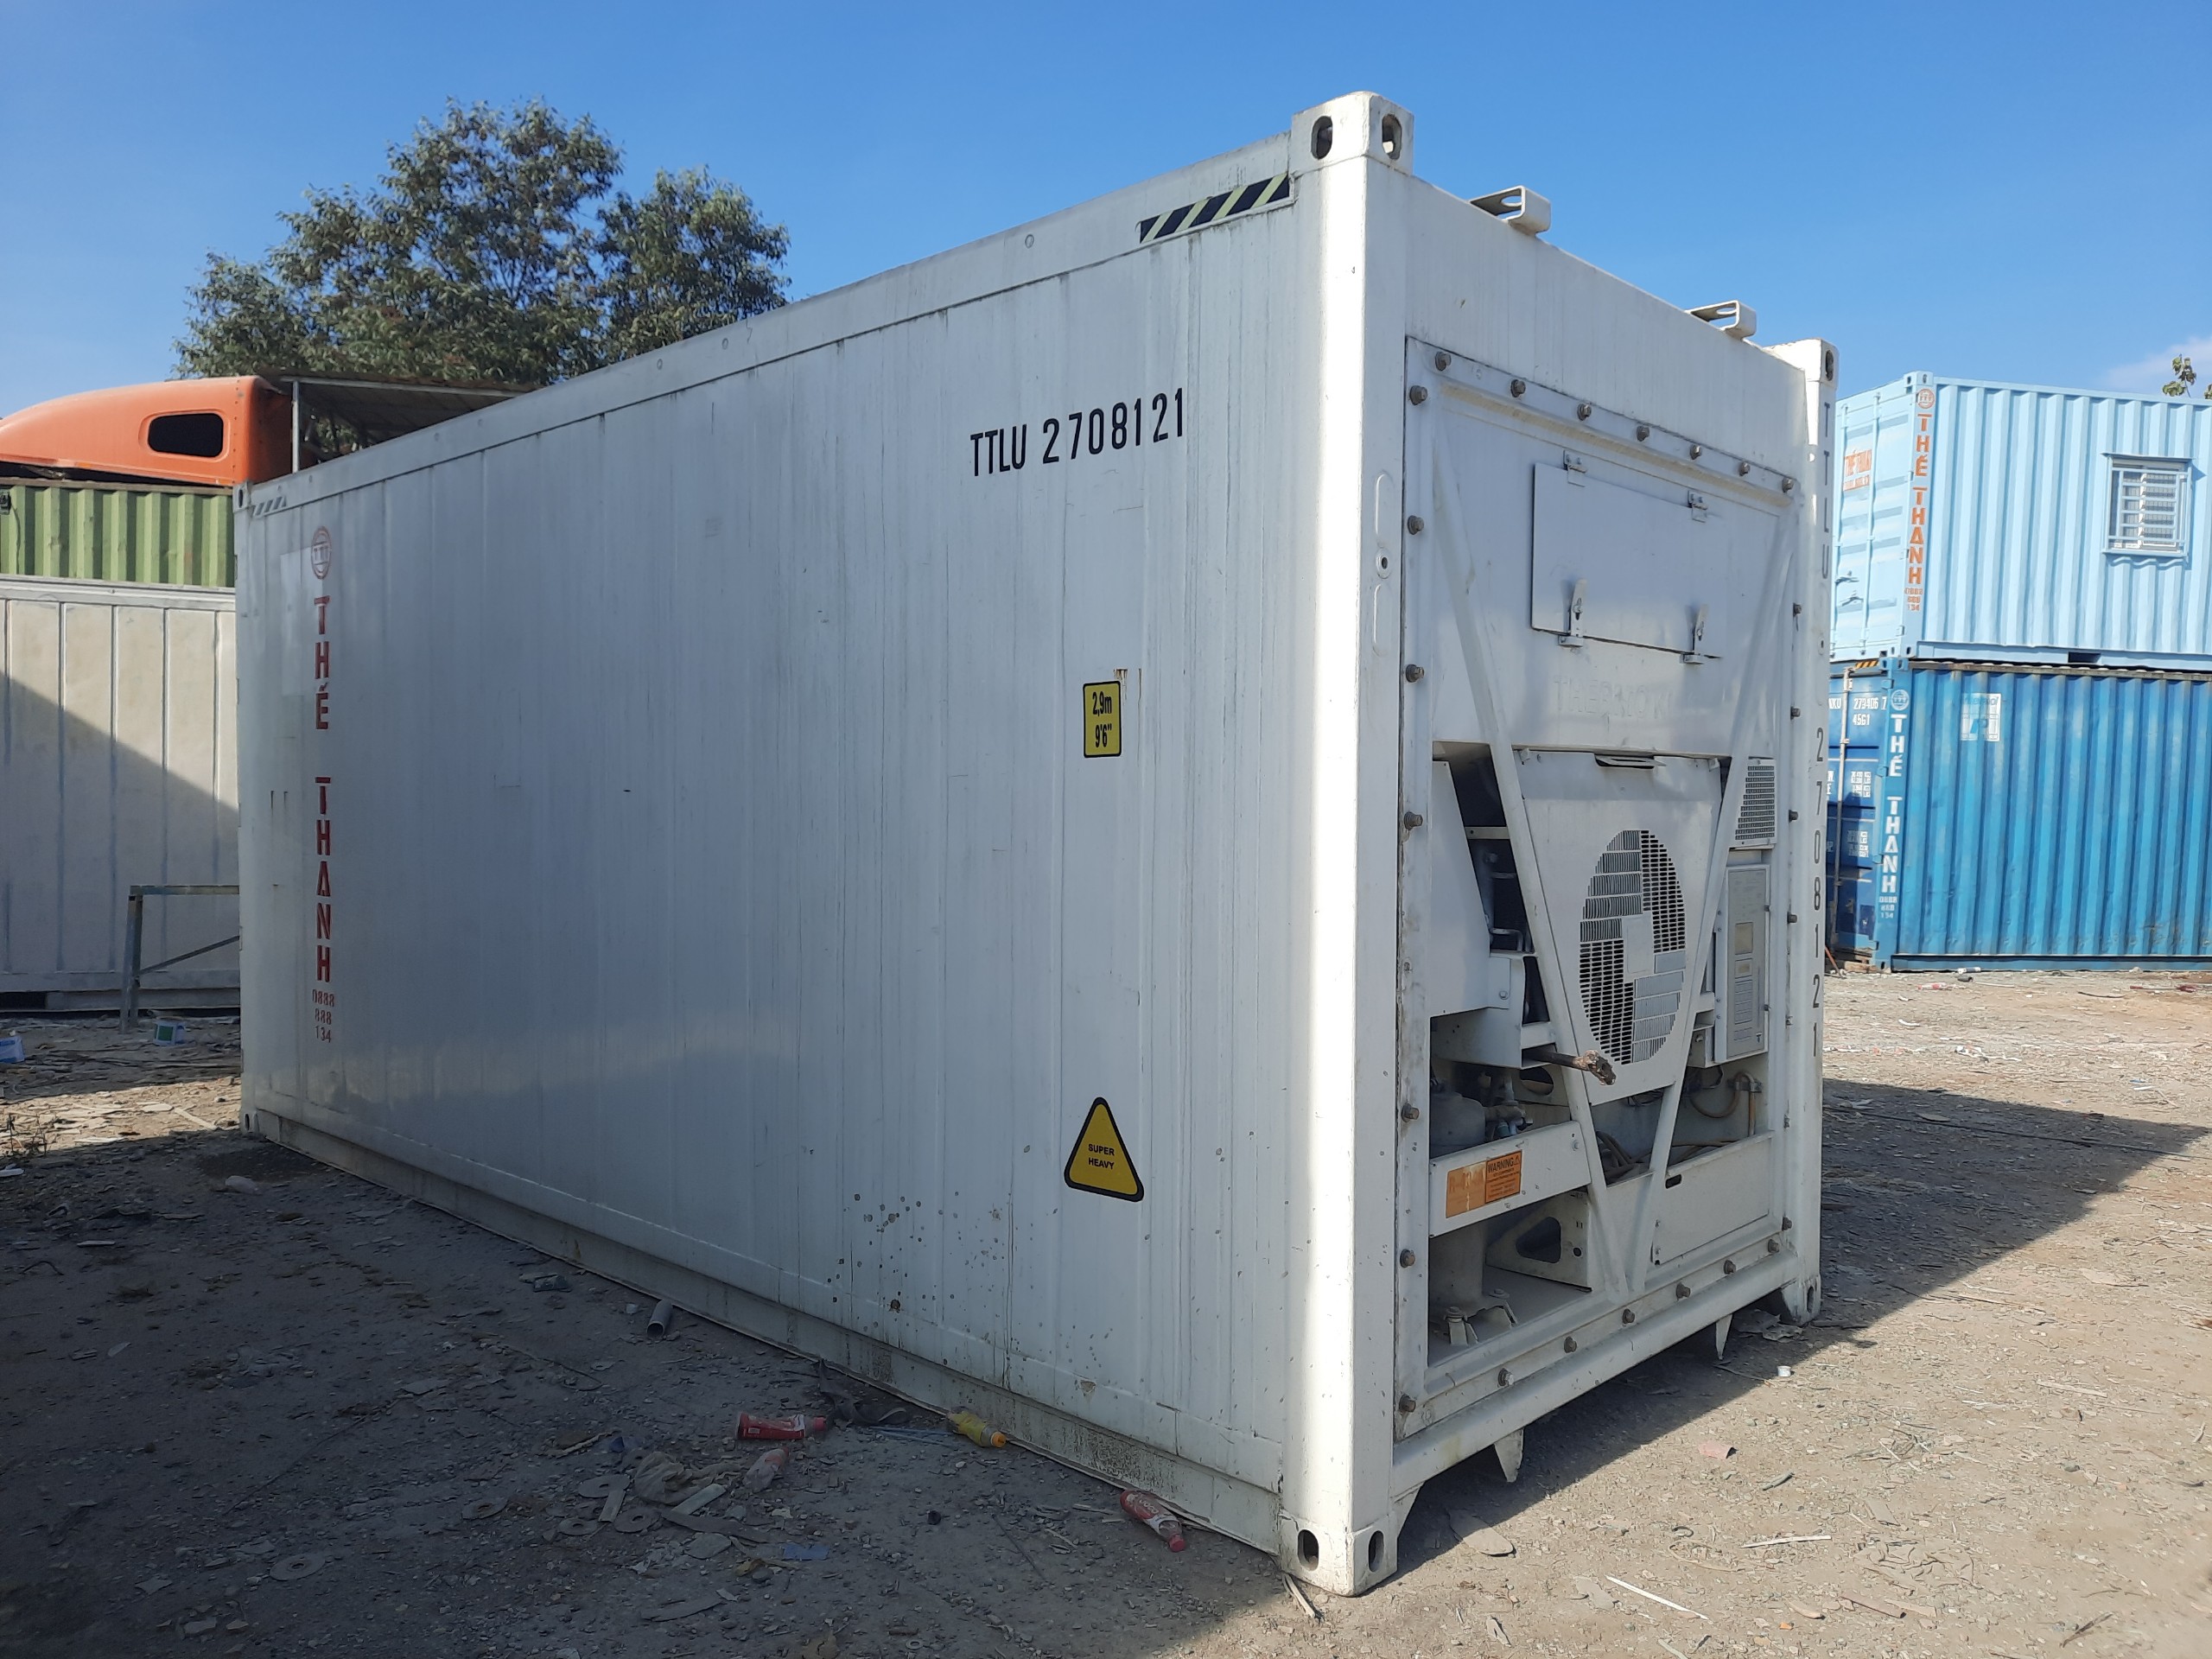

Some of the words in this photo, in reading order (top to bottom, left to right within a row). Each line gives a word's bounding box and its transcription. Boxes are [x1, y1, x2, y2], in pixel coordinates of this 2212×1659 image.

[969, 423, 1027, 477] TTLU
[1042, 387, 1184, 464] 2708121
[1821, 403, 1831, 580] TTLU
[1907, 486, 1929, 585] THANH
[315, 777, 332, 983] THANH
[1881, 796, 1904, 893] THANH
[315, 1025, 332, 1044] 134
[1088, 1143, 1115, 1156] SUPER
[1088, 1157, 1116, 1170] HEAVY
[1486, 1158, 1514, 1174] WARNING
